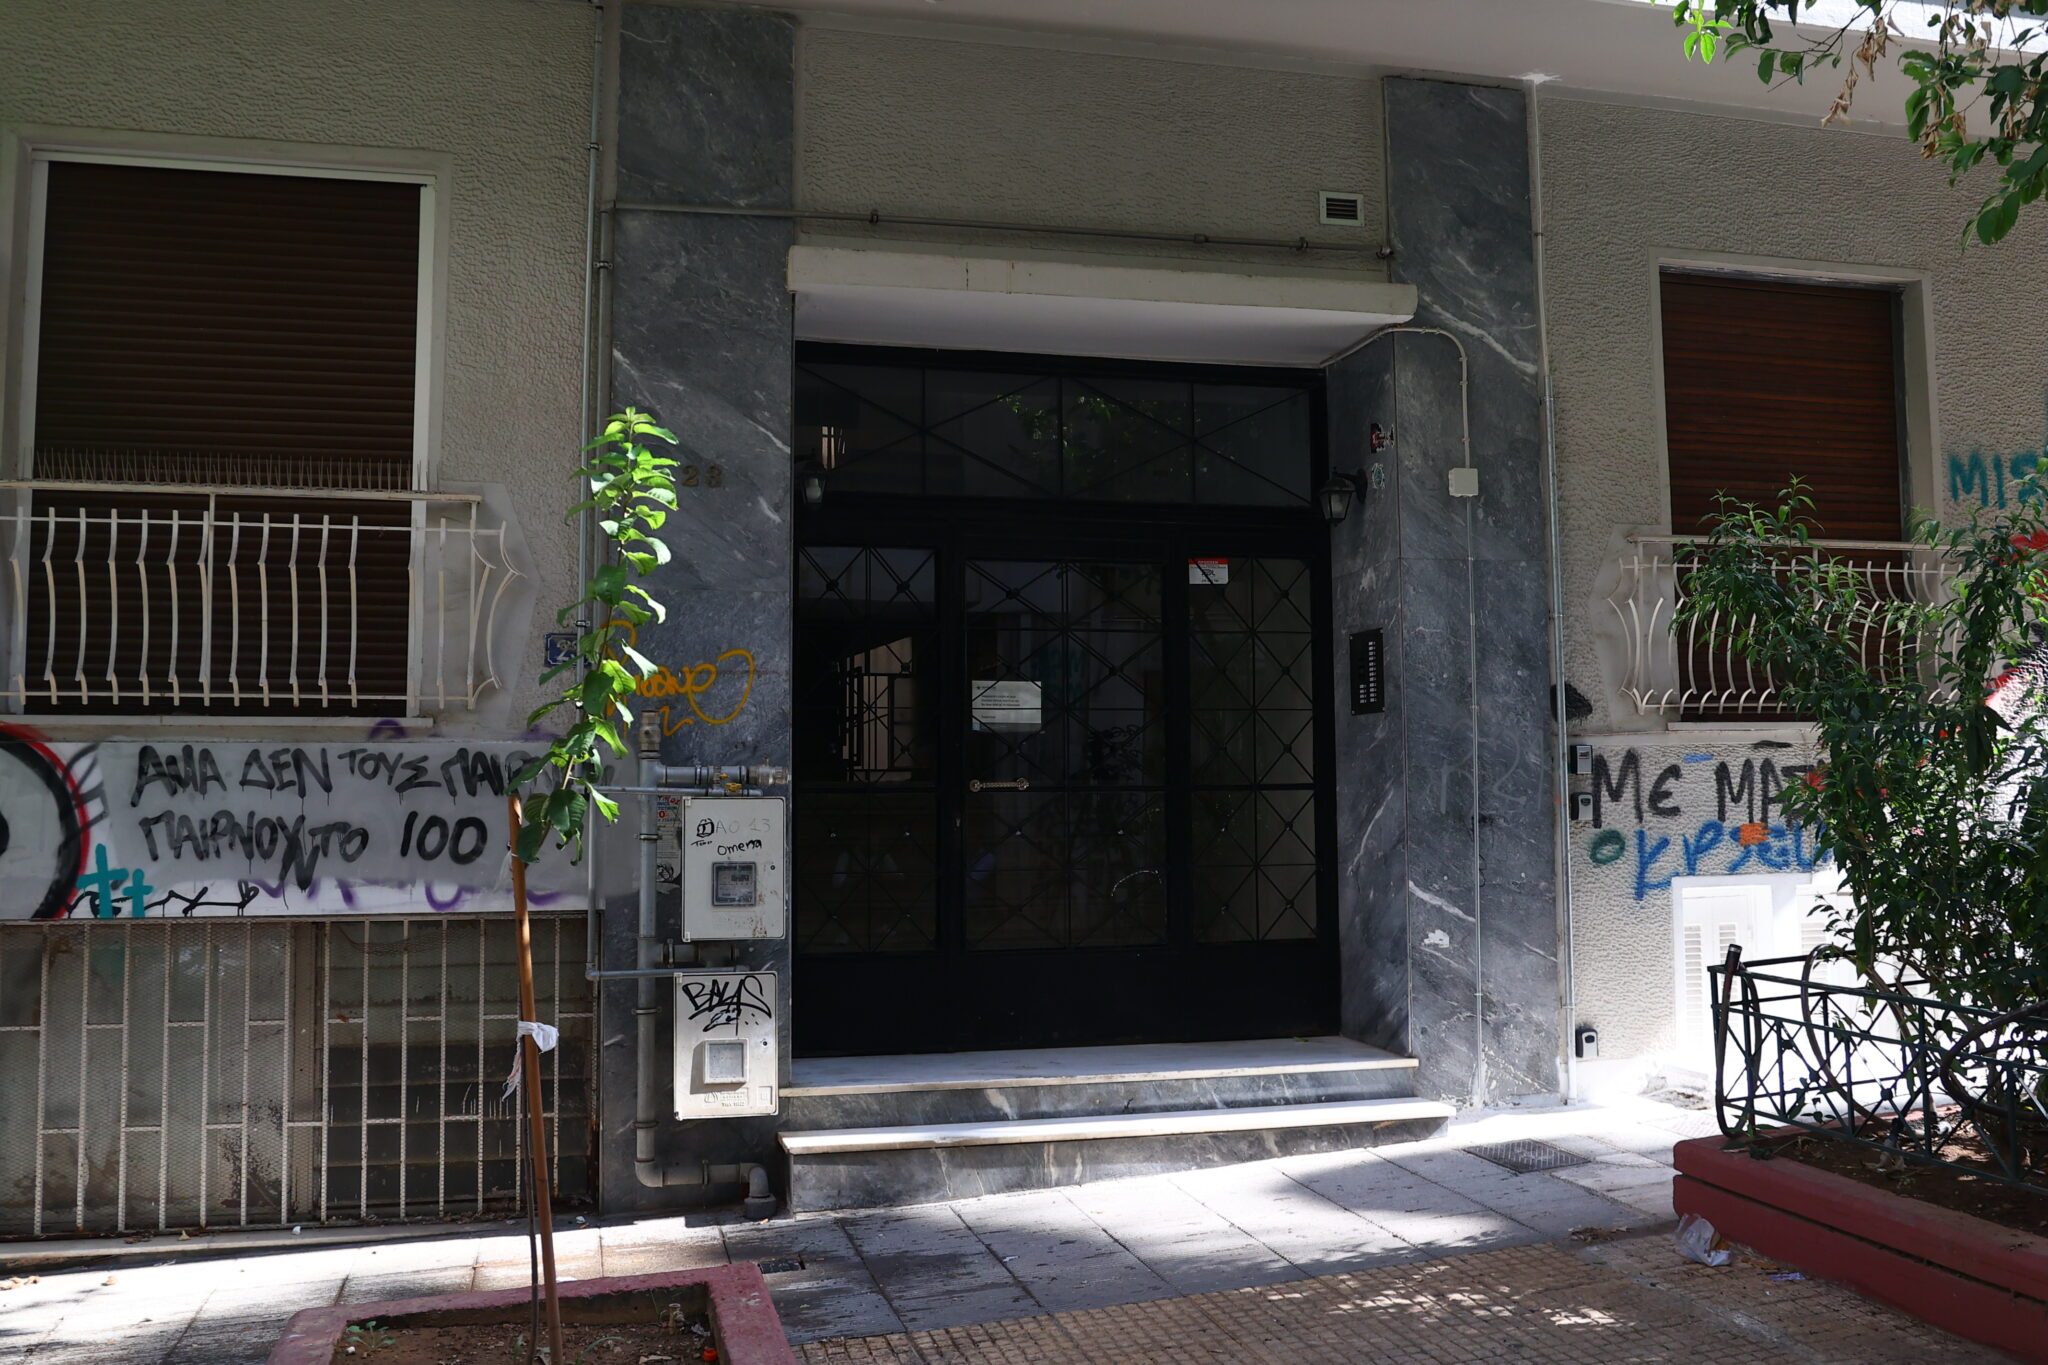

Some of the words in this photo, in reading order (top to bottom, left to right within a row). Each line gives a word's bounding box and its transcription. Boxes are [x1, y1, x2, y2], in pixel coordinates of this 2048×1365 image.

[239, 747, 333, 800] ΔΕΝ
[338, 748, 442, 793] ΤΟΥΣ
[308, 821, 370, 863] ΤΟ
[400, 810, 488, 865] 100
